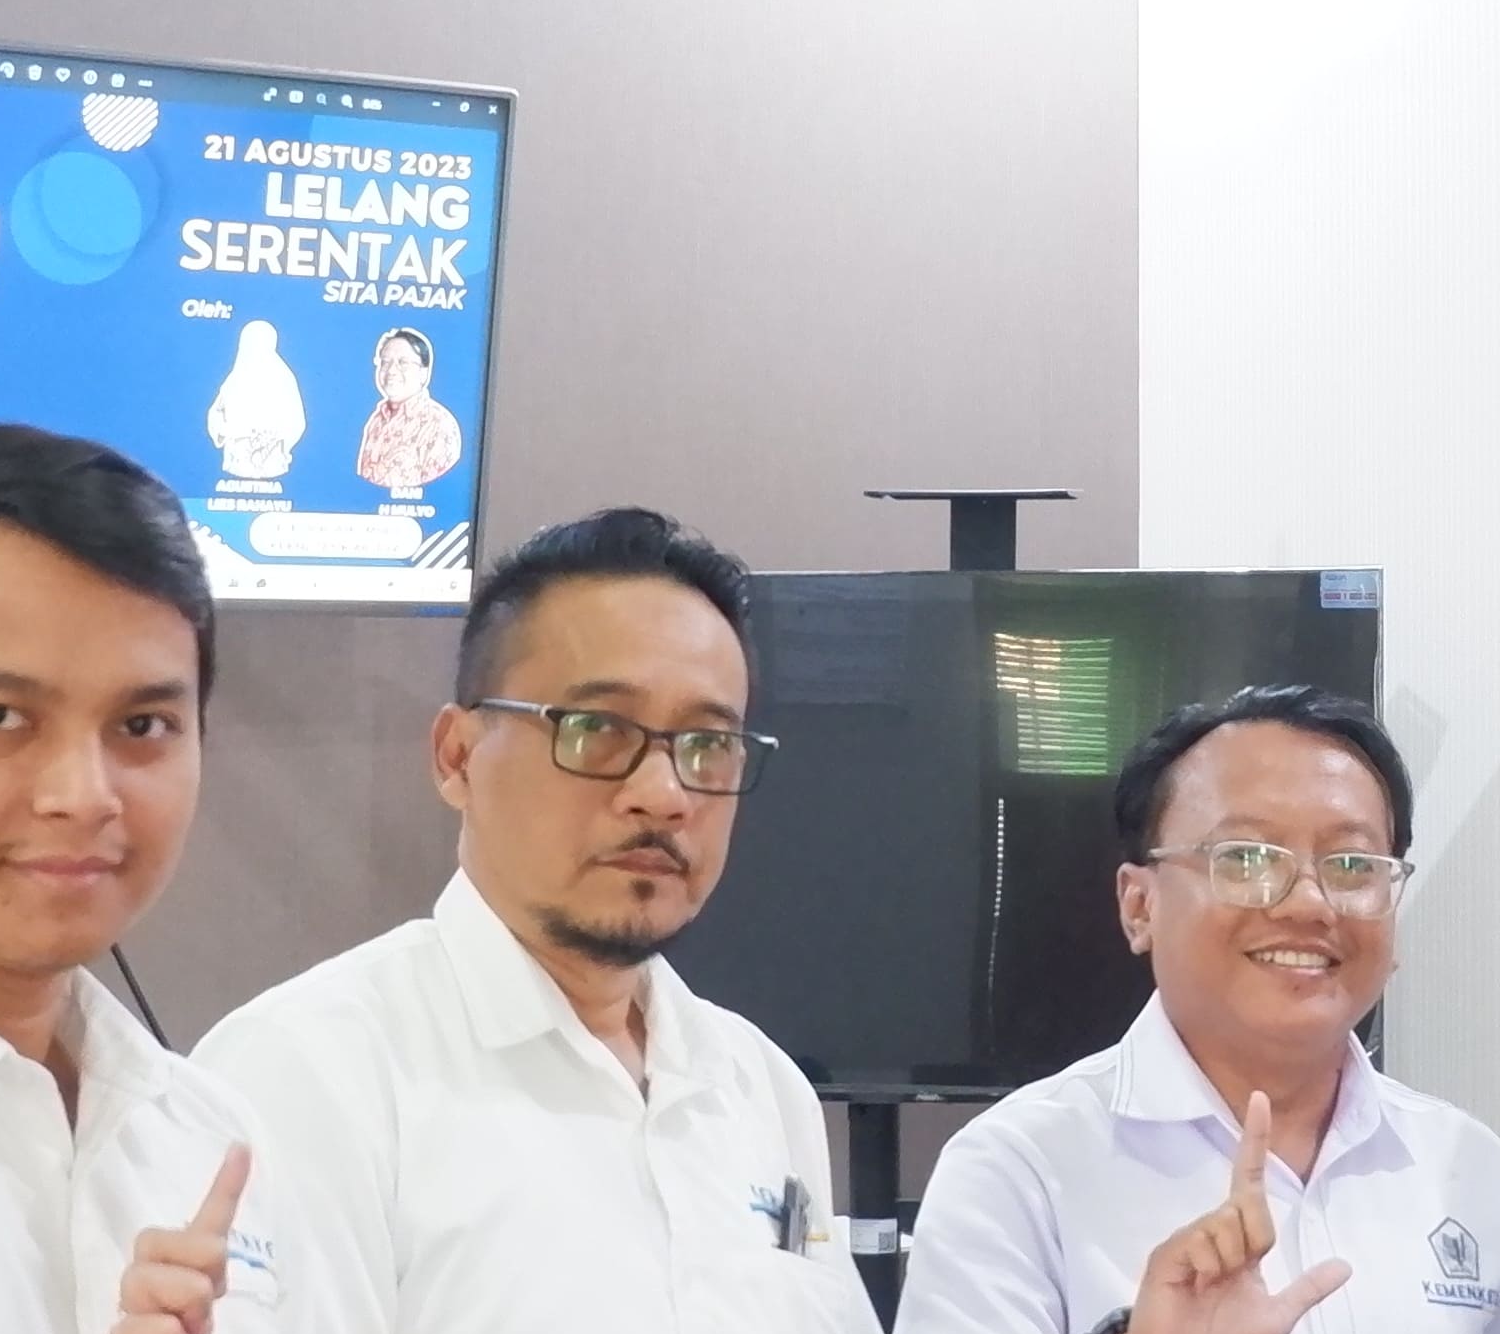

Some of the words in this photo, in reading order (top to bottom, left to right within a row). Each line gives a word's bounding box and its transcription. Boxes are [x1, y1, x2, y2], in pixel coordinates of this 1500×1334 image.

[203, 134, 236, 161] 21
[243, 137, 393, 173] AGUSTUS
[399, 151, 473, 180] 2023
[264, 171, 471, 231] LELANG
[179, 218, 469, 287] SERENTAK
[181, 298, 234, 320] Oleh:
[323, 280, 378, 305] SITA
[383, 284, 468, 311] PAJAK
